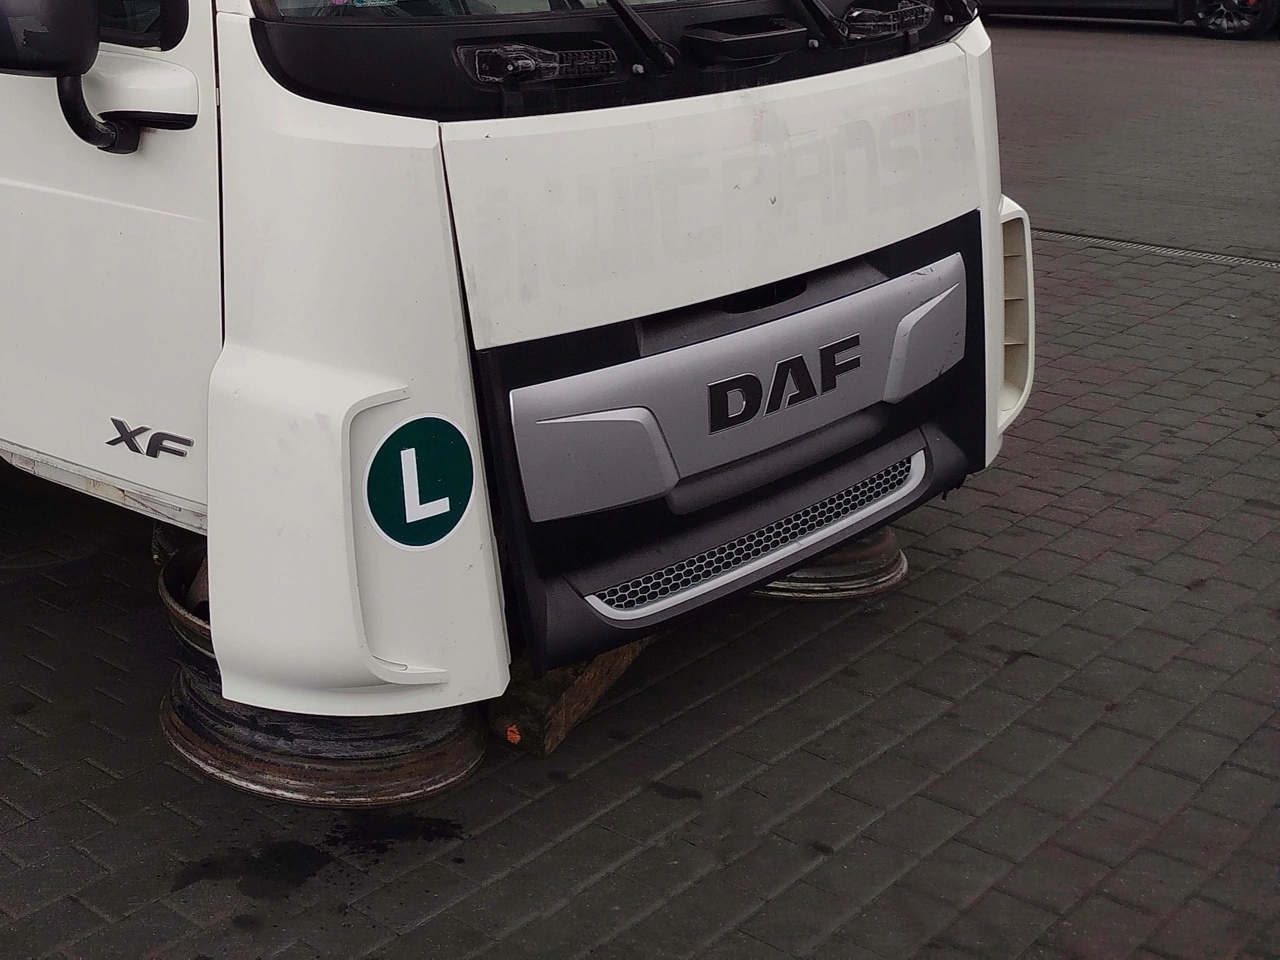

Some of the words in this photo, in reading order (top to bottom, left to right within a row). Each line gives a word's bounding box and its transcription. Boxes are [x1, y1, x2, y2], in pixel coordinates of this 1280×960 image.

[706, 332, 861, 436] DAF
[104, 416, 195, 459] XF
[400, 447, 451, 524] L
